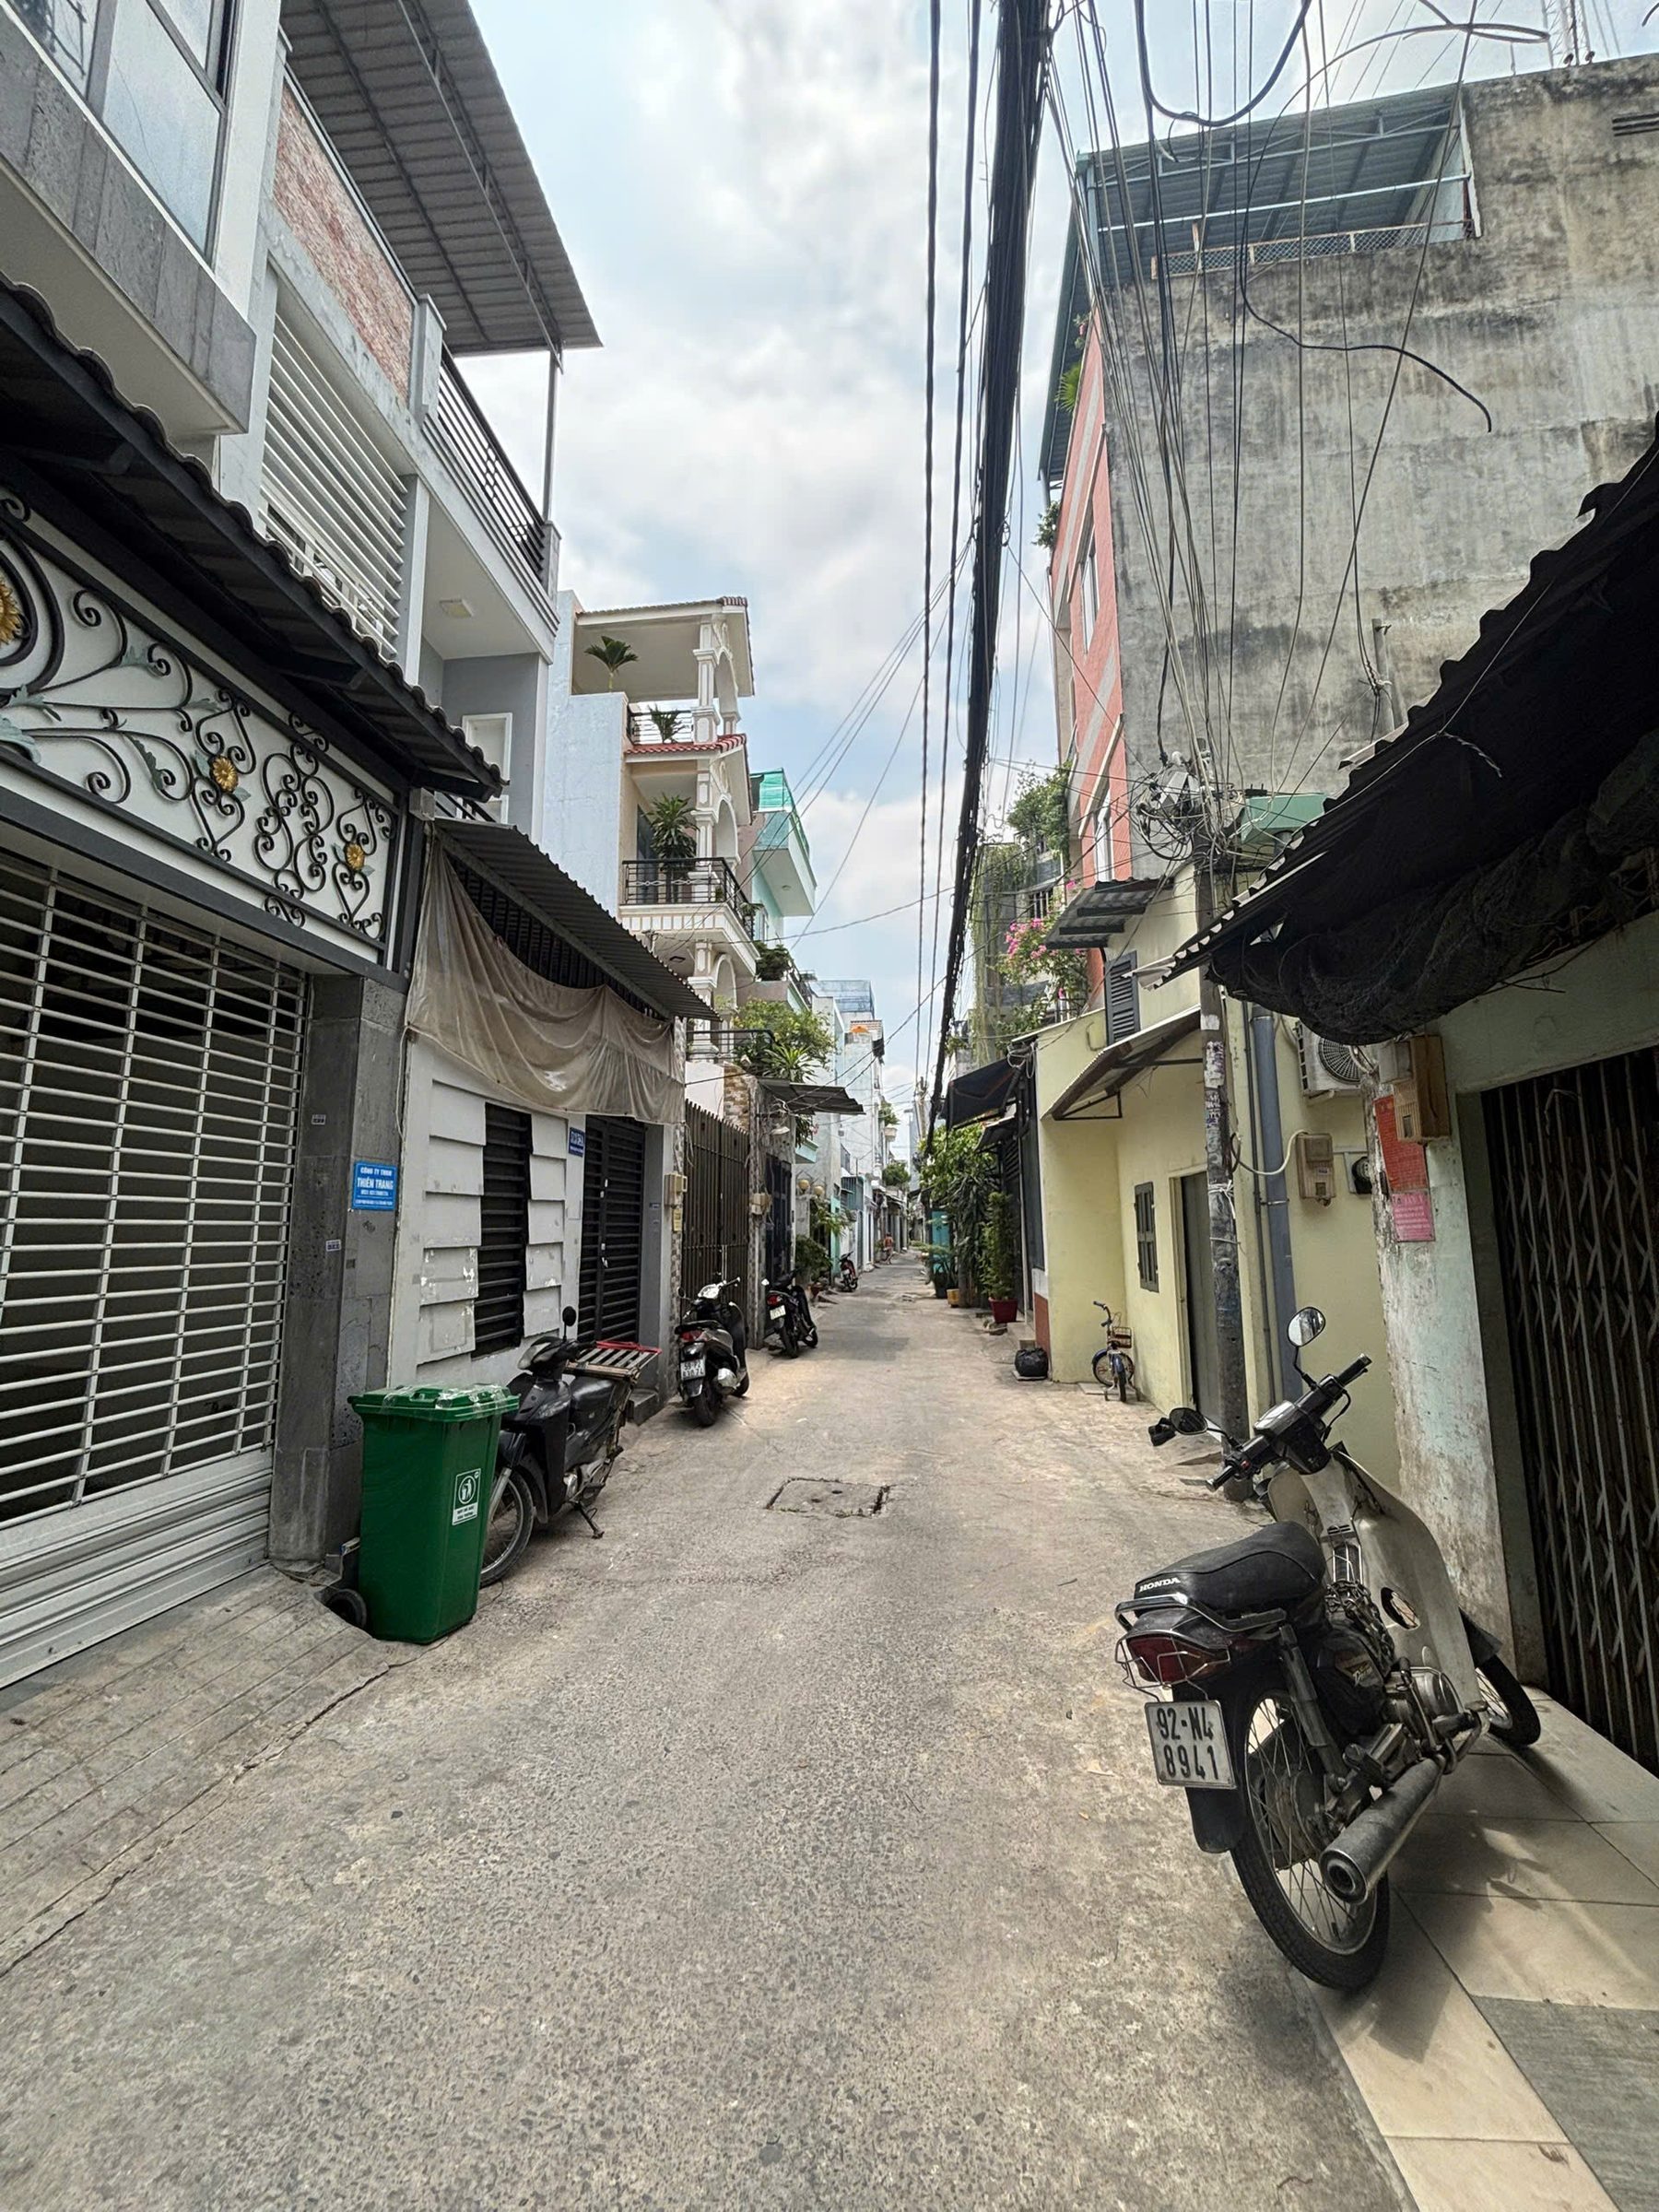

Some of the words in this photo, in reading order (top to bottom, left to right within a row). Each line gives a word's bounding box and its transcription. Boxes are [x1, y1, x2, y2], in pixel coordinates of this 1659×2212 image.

[1139, 1577, 1181, 1593] HONDA
[1157, 1707, 1214, 1741] 92-N4
[1163, 1744, 1218, 1780] 8941
